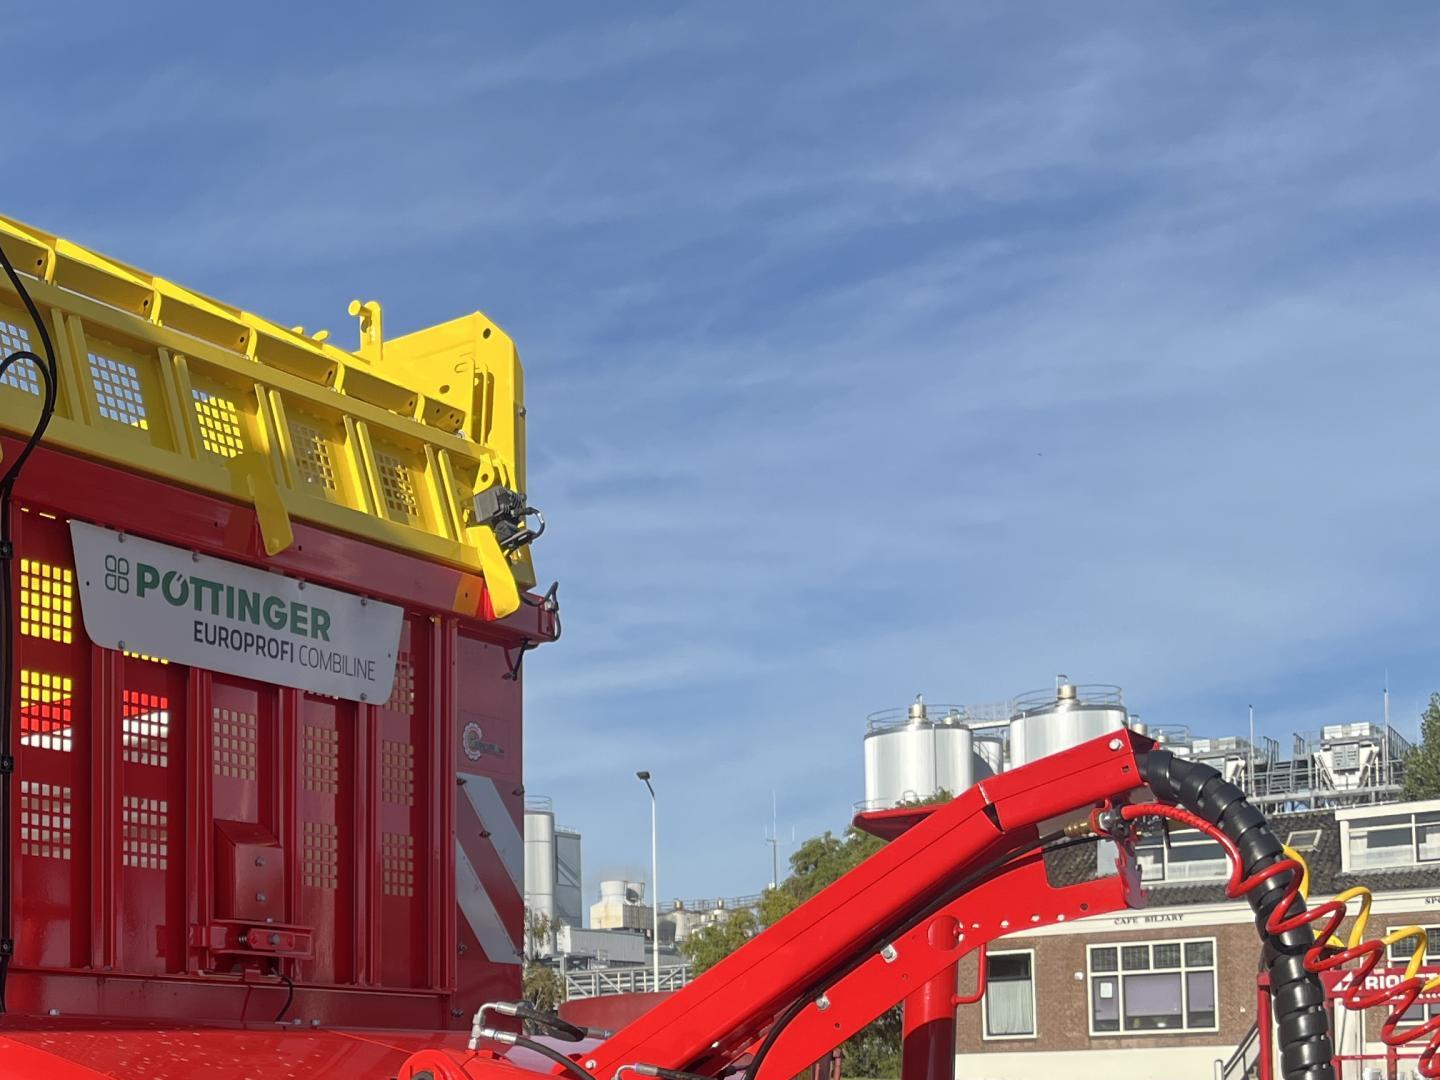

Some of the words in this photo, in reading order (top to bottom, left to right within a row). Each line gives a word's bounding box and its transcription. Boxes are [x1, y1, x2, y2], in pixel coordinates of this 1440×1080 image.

[136, 562, 332, 642] PÖTTINGER
[193, 621, 295, 663] EUROPROFI
[299, 640, 376, 682] COMBILINE
